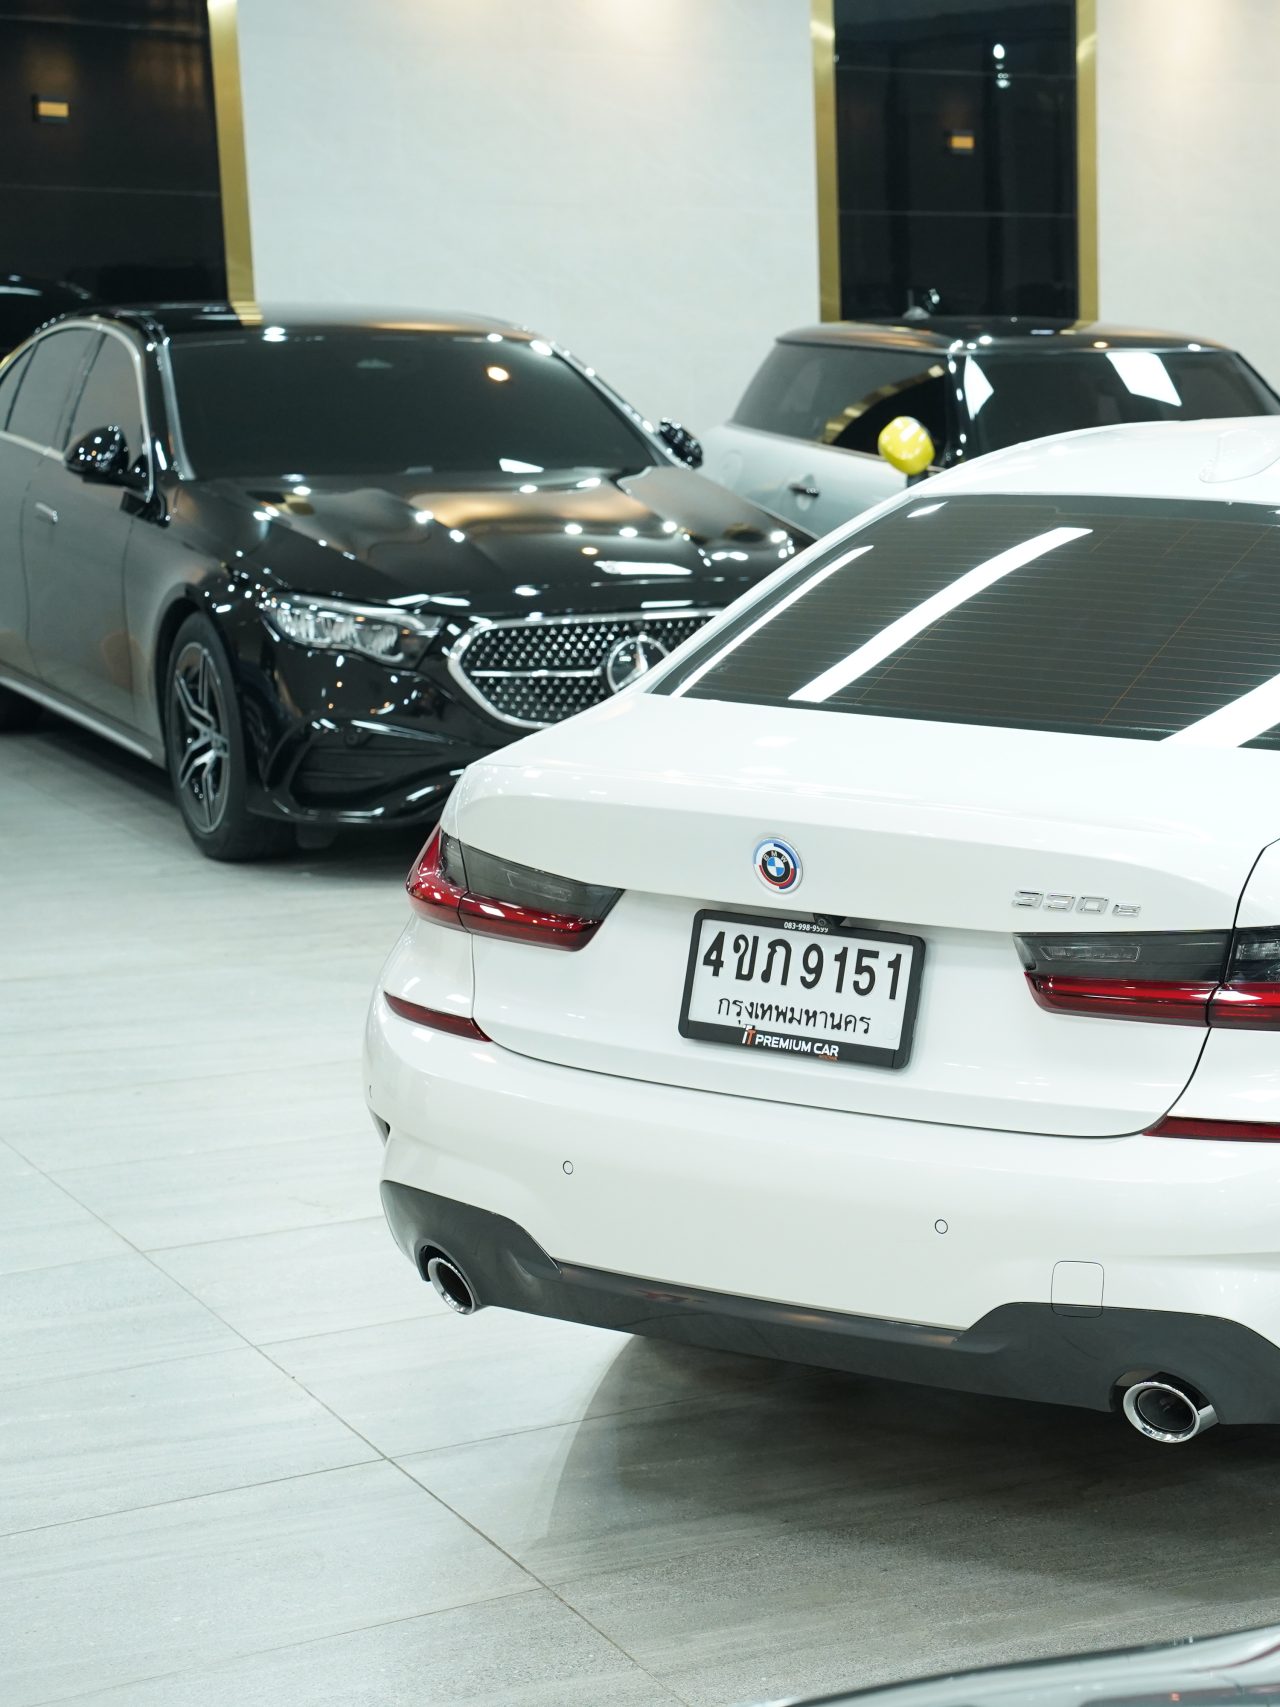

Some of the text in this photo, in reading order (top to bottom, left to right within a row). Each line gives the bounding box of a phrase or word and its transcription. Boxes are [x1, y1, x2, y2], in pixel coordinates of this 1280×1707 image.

[763, 850, 788, 863] BMW
[717, 997, 872, 1035] กรุงเทพมหานคร
[755, 1033, 812, 1053] PREMIUM
[813, 1042, 840, 1057] CAR
